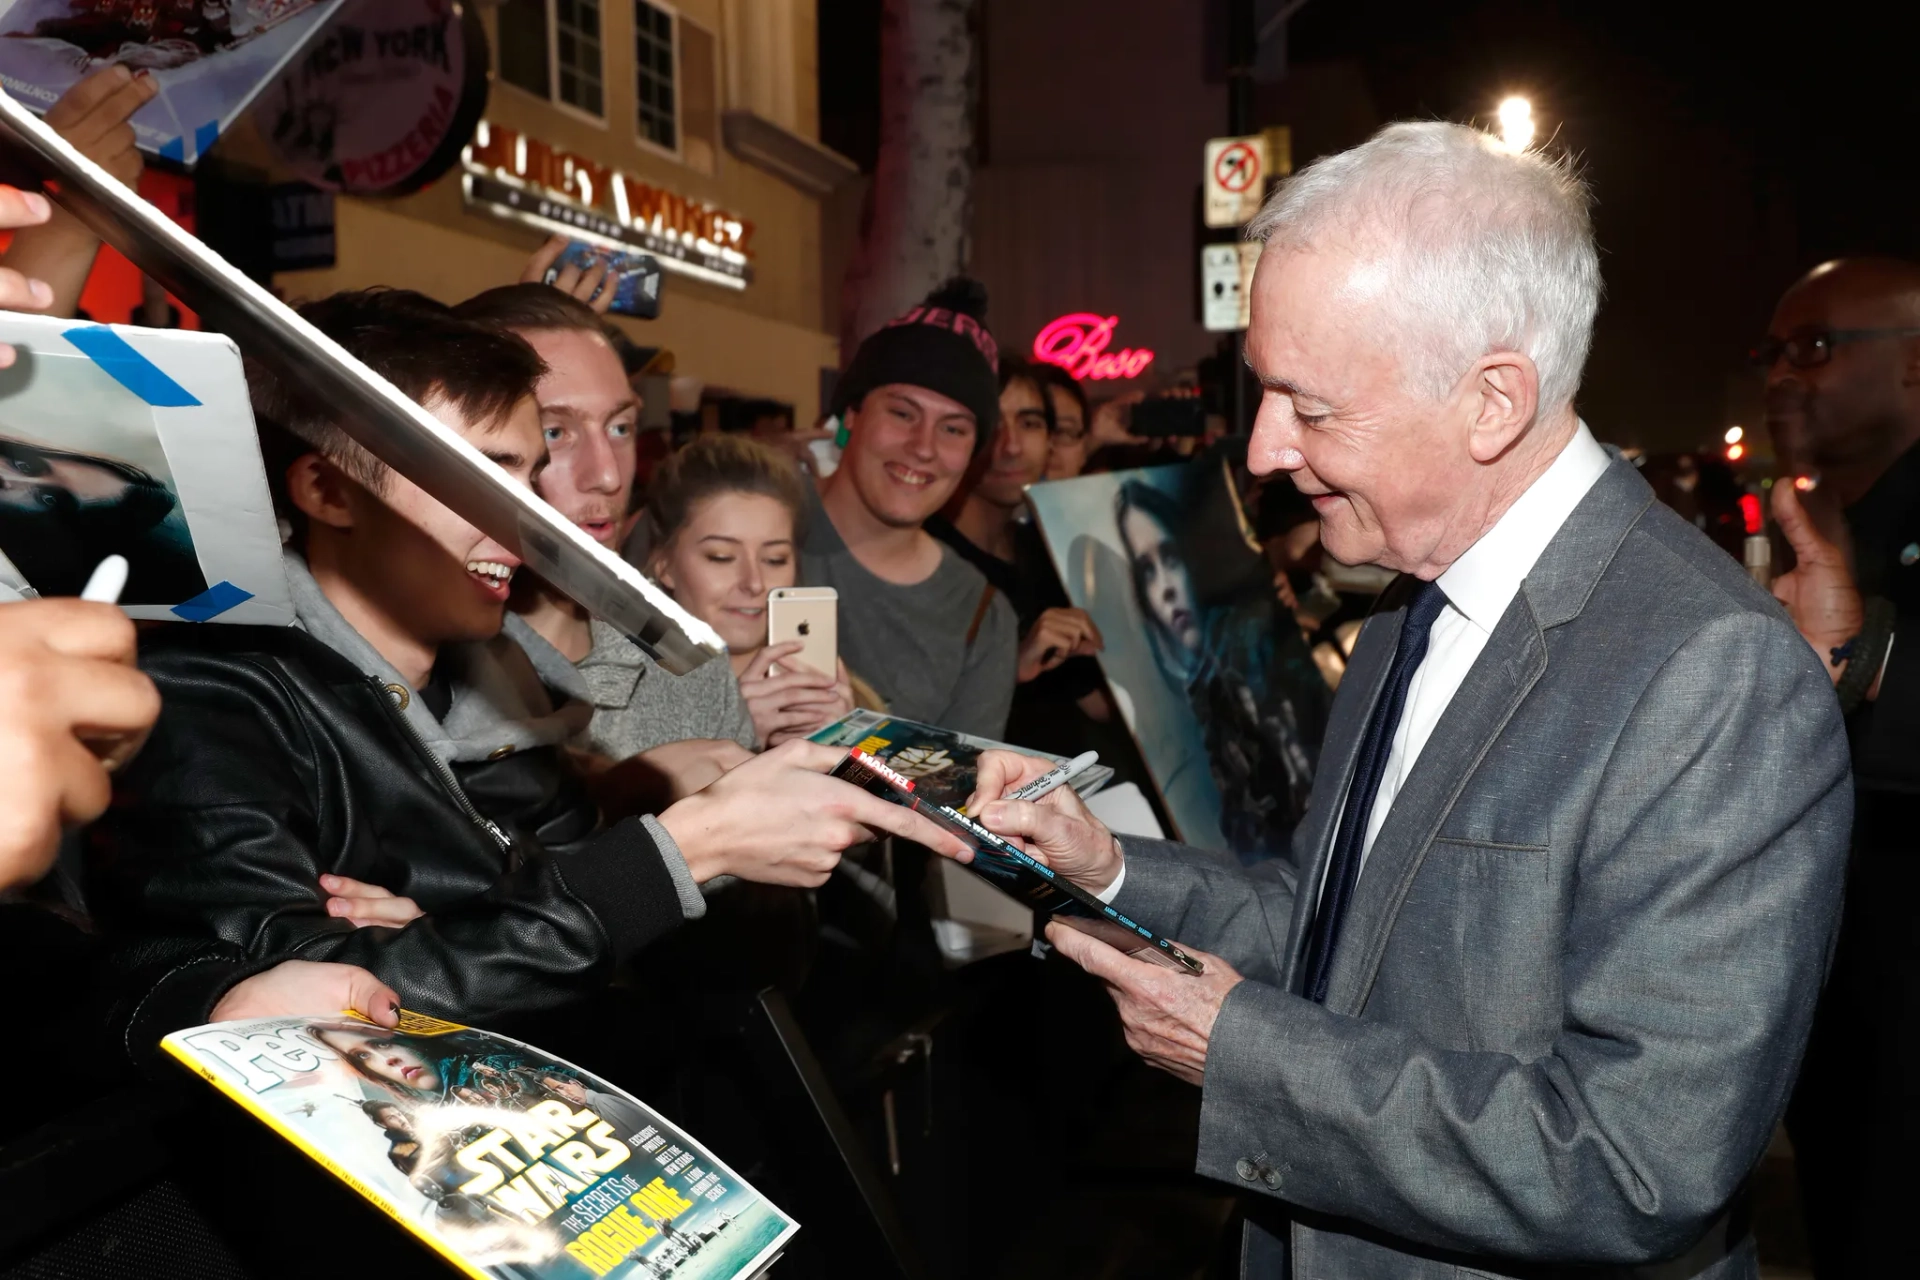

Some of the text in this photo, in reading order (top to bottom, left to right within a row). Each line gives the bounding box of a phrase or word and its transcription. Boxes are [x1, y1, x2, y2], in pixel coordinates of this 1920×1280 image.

[302, 14, 451, 86] NEW YORK
[341, 86, 456, 185] PIZZERIA
[1034, 312, 1154, 380] Beso
[858, 751, 911, 790] MARVEL
[940, 806, 1056, 879] STAR WARS SKYWALKER STRIKES
[457, 1099, 600, 1195] STAR
[628, 1124, 659, 1147] EXCLUSIVE
[641, 1134, 667, 1154] PHOTOS
[655, 1144, 683, 1166] MEET THE
[487, 1119, 631, 1226] WARS
[663, 1151, 696, 1176] NEW STARS
[687, 1166, 706, 1182] LOOK
[690, 1171, 721, 1197] BEHIND THE
[560, 1173, 642, 1235] THE SECRETS OF
[704, 1183, 728, 1202] SCENES
[564, 1176, 694, 1277] ROGUE ONE
